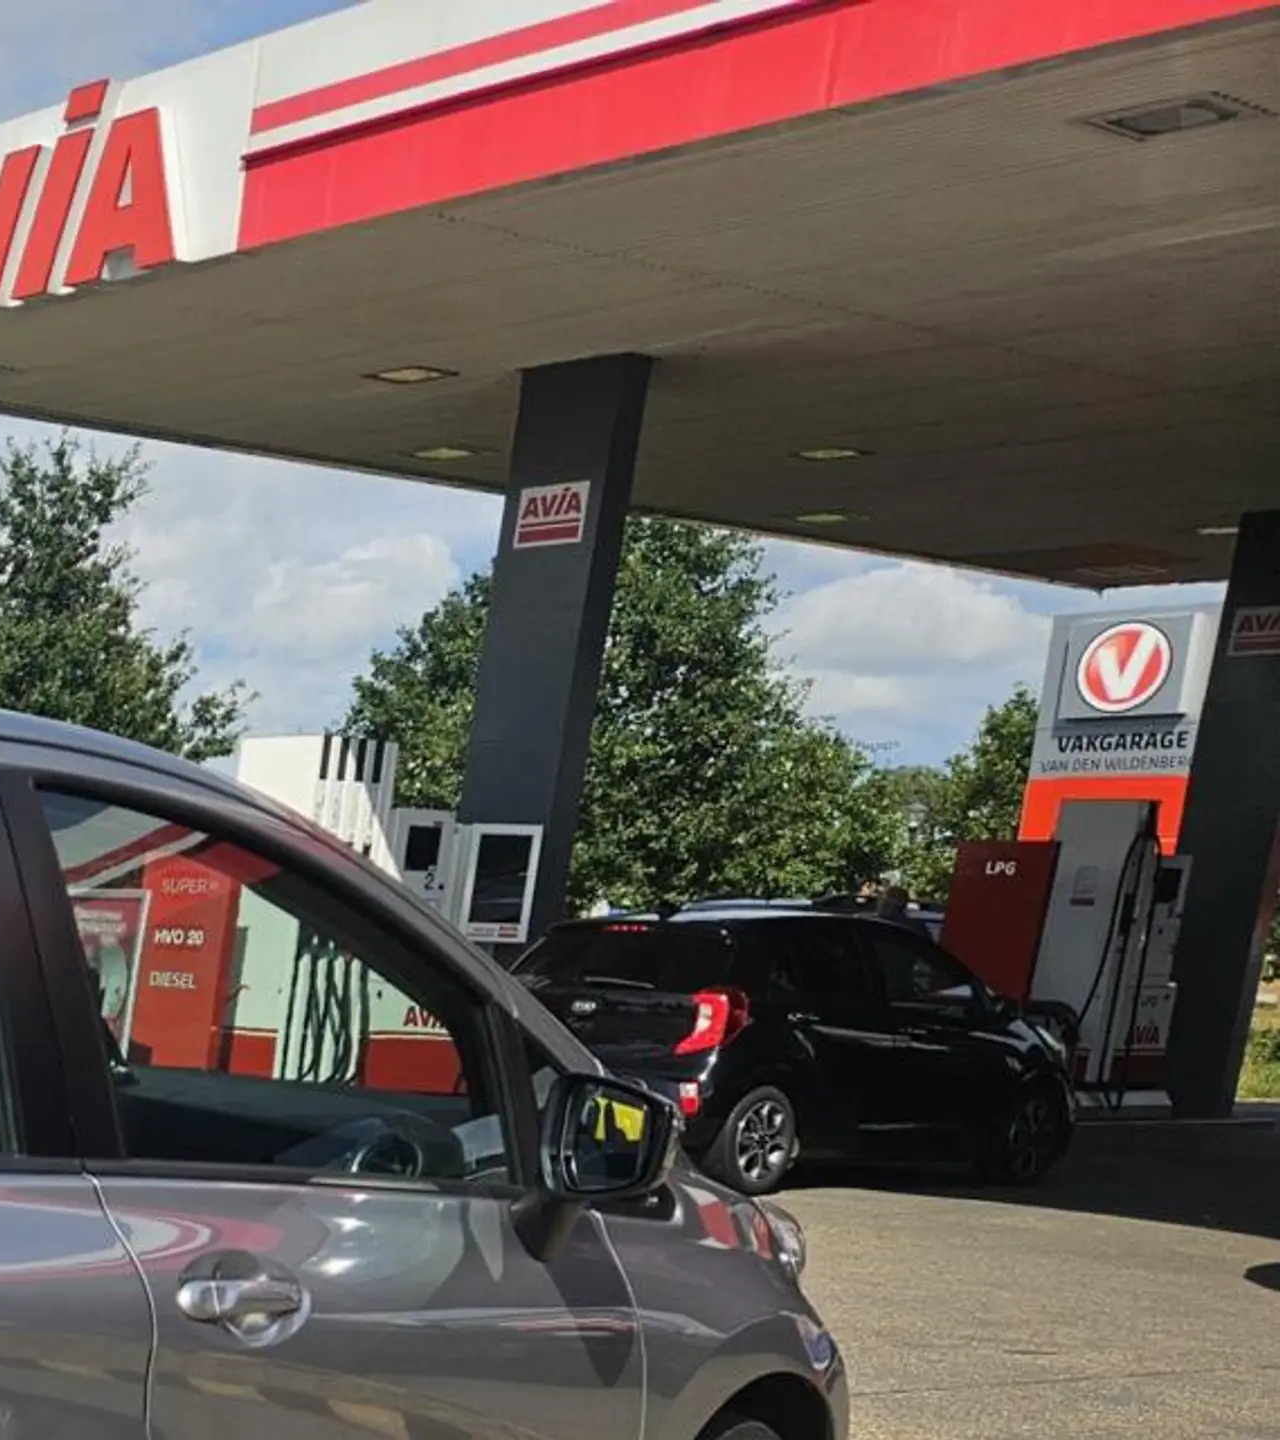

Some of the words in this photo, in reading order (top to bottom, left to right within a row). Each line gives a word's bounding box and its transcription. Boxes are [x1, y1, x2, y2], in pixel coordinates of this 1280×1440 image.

[521, 486, 582, 520] AVIA
[1057, 730, 1189, 753] VAKGARAGE
[1041, 759, 1070, 774] VAN
[1072, 757, 1101, 772] DEN
[985, 861, 1017, 876] LPG
[161, 876, 209, 894] SUPER
[154, 928, 184, 945] HVO
[187, 928, 205, 946] 20
[149, 971, 196, 989] DIESEL
